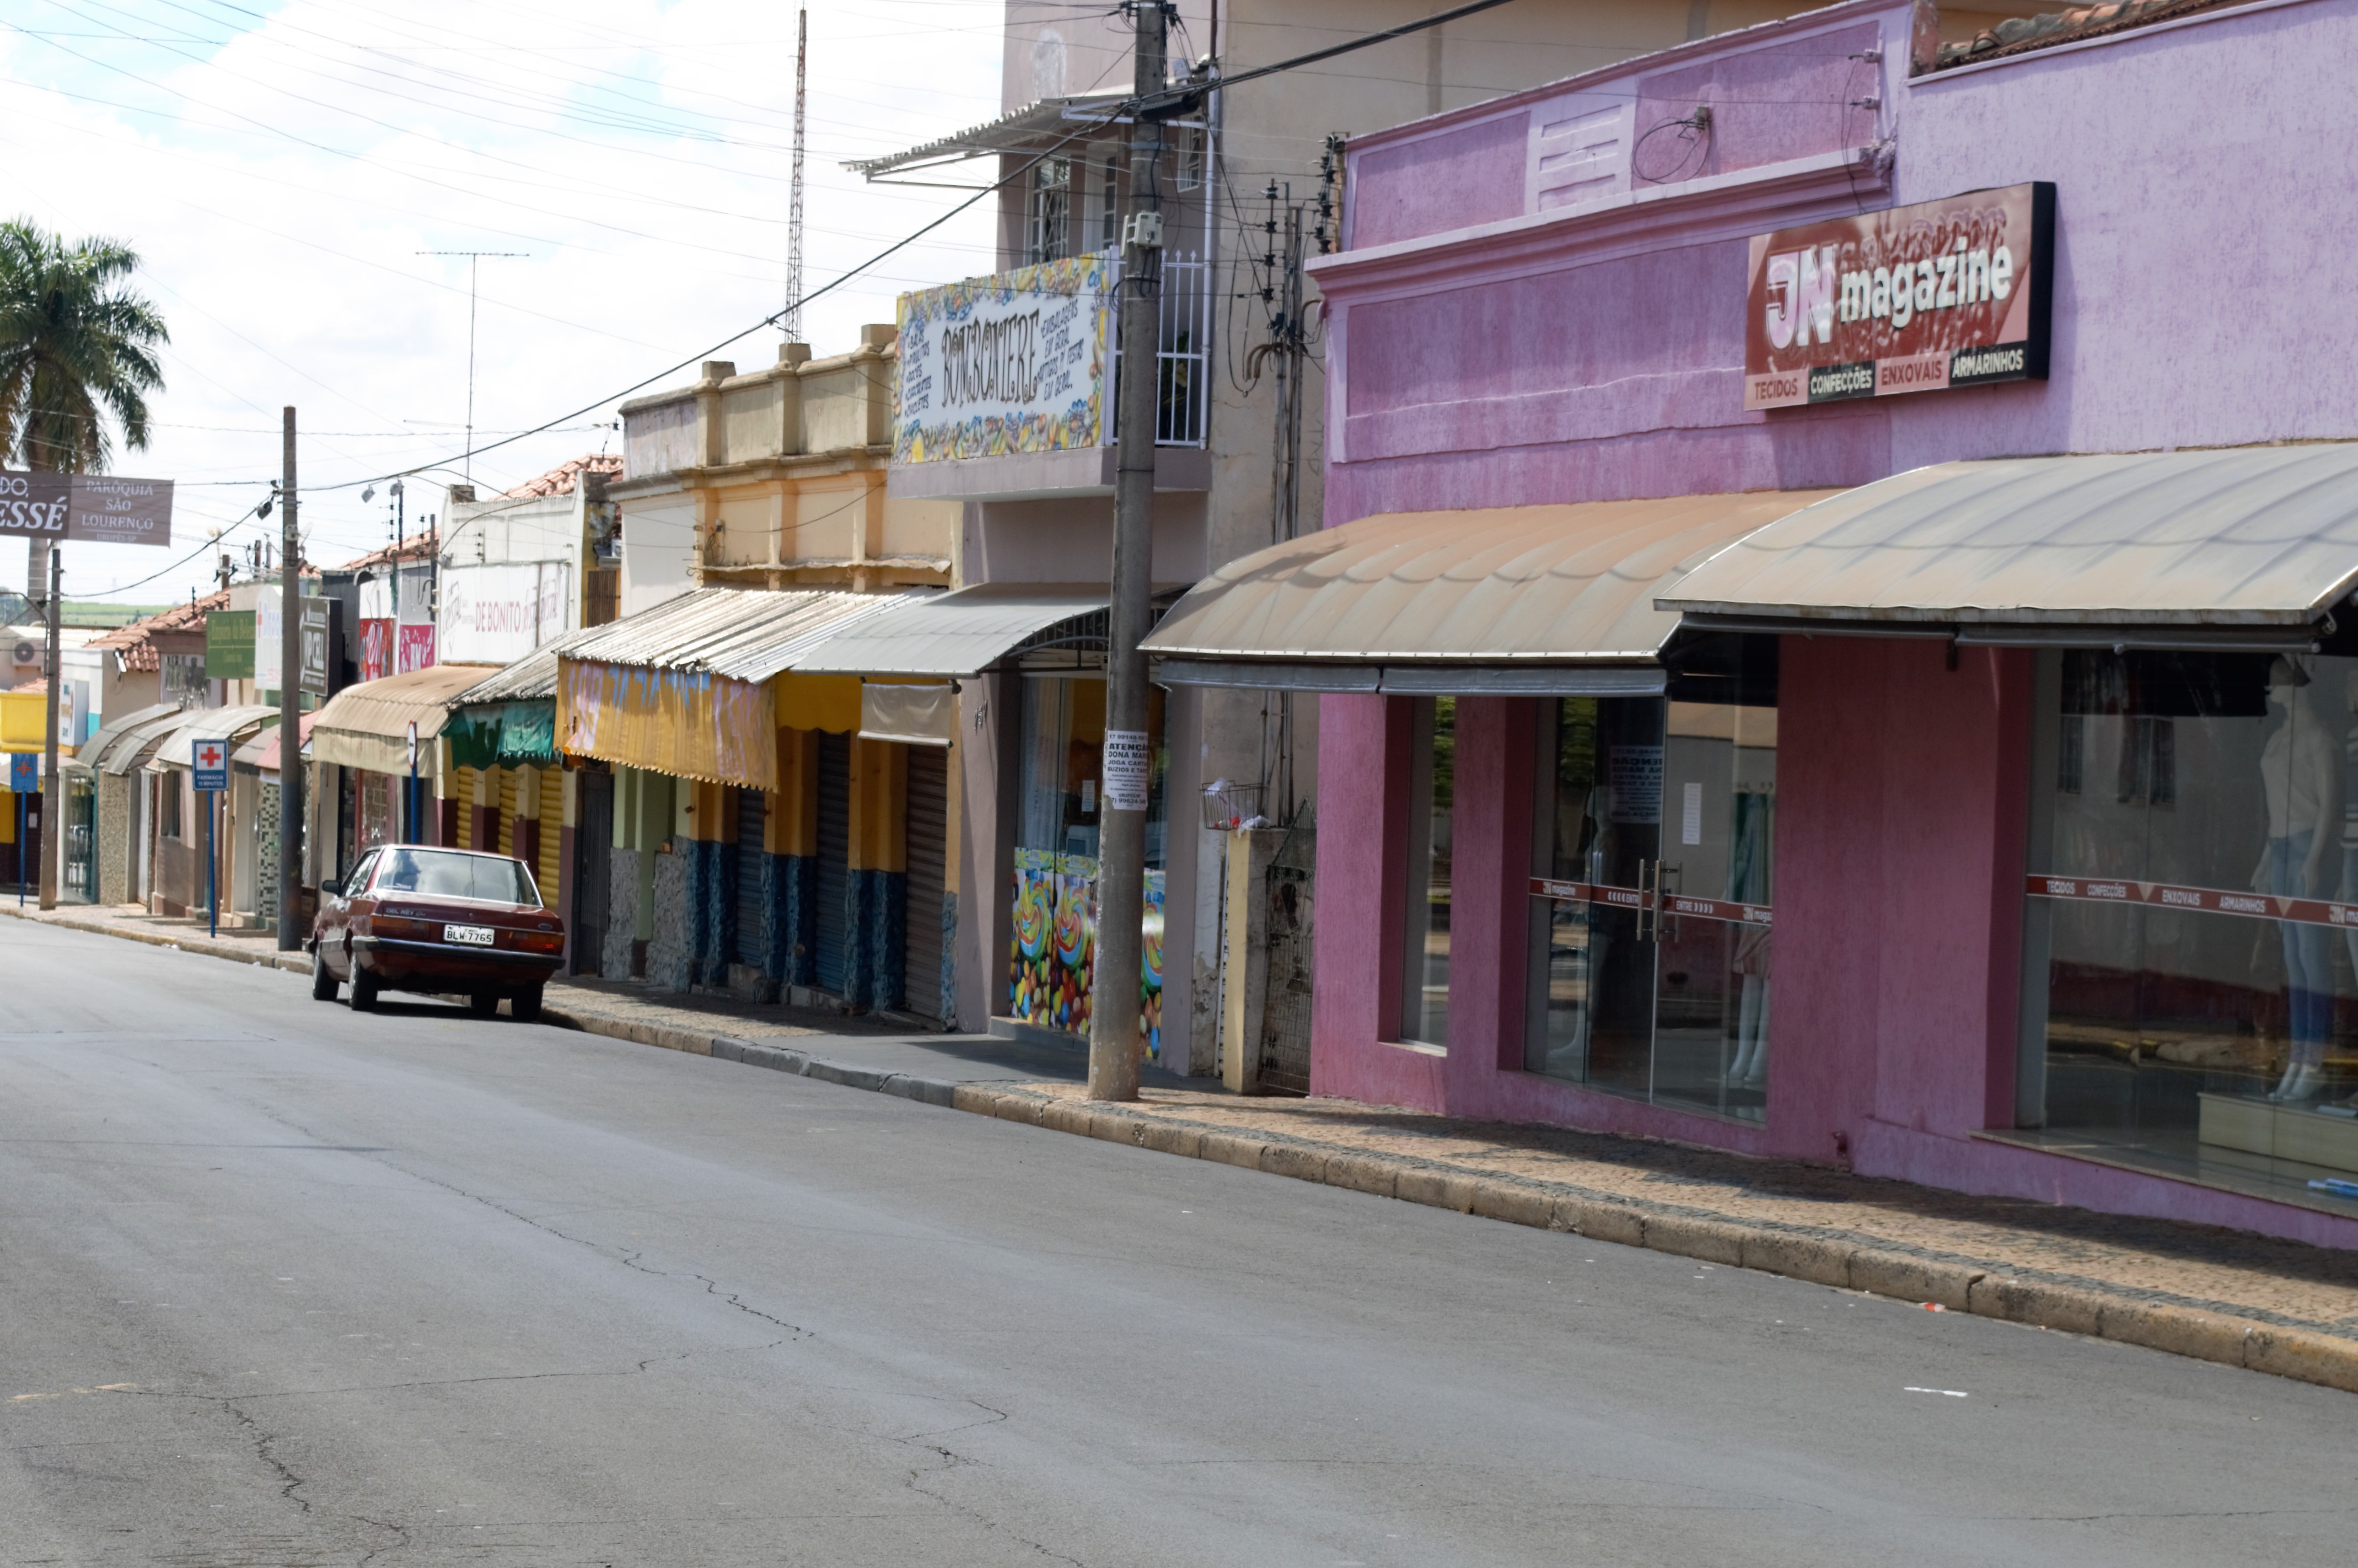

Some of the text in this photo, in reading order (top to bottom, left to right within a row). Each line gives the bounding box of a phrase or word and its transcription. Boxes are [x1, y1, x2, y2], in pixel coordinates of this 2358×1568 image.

[1766, 235, 2013, 350] JN magazine
[1044, 298, 1078, 339] EMBALAGENS
[941, 308, 1040, 409] BOMBONIERE
[1952, 348, 2023, 378] ARMARINHOS
[1810, 367, 1873, 395] CONFECÇÕES
[1881, 360, 1942, 386] ENXOVAIS
[1754, 378, 1799, 400] TECIDOS
[86, 480, 154, 497] PARÓQUIA
[105, 497, 132, 511] SÃO
[82, 514, 154, 532] LOURENÇO
[476, 600, 521, 633] DE BONITO
[1552, 884, 1576, 896] magazine
[2046, 880, 2076, 895] TECIDOS
[2087, 882, 2126, 899] CONFECÇÕES
[2162, 889, 2200, 906] ENXOVAIS
[2220, 895, 2266, 914] ARMARINHOS
[1676, 900, 1693, 911] ENTRE
